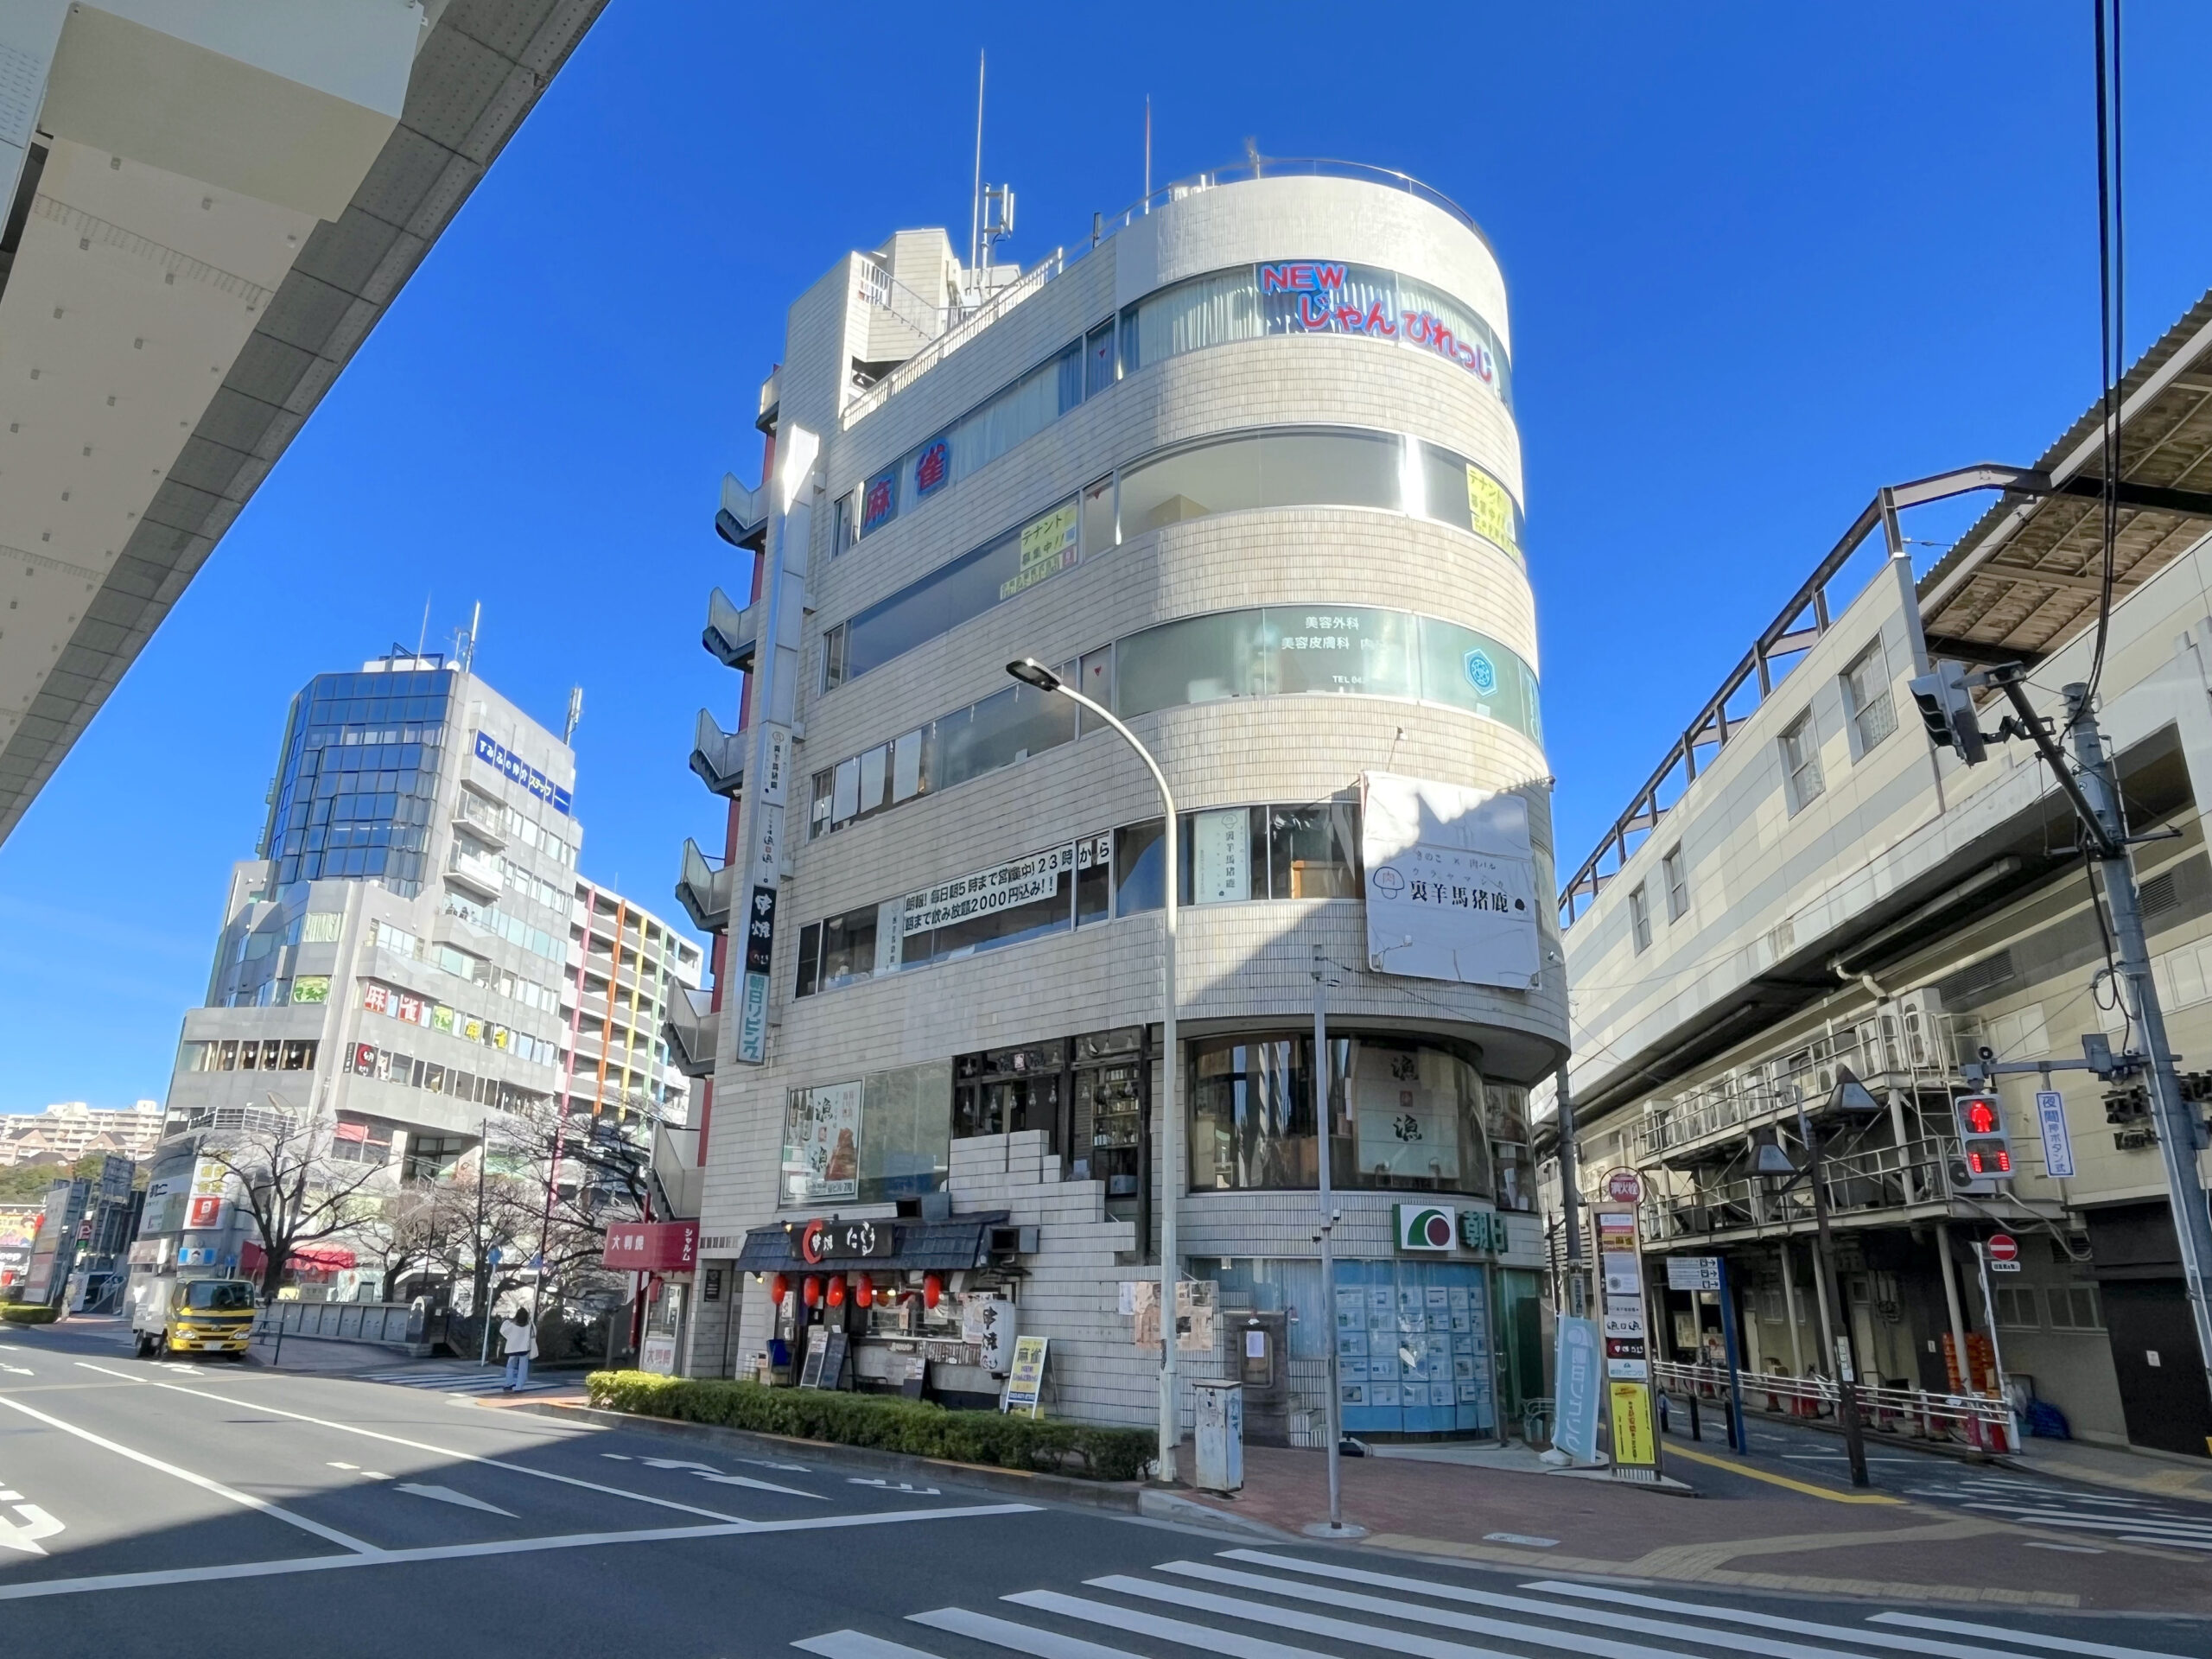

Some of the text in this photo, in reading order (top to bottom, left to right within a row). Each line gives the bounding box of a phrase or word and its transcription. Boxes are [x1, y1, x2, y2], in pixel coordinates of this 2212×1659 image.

[1264, 266, 1344, 289] NEW
[865, 443, 944, 527] 麻雀
[1022, 515, 1062, 546] テナント
[1306, 617, 1359, 630] 美容外科
[1281, 637, 1350, 650] 美容皮膚科
[1410, 880, 1509, 912] 裏羊馬猪鹿
[365, 985, 419, 1022] 麻雀
[2042, 1096, 2067, 1173] 夜間押ボタン式
[683, 1228, 693, 1261] シャルム
